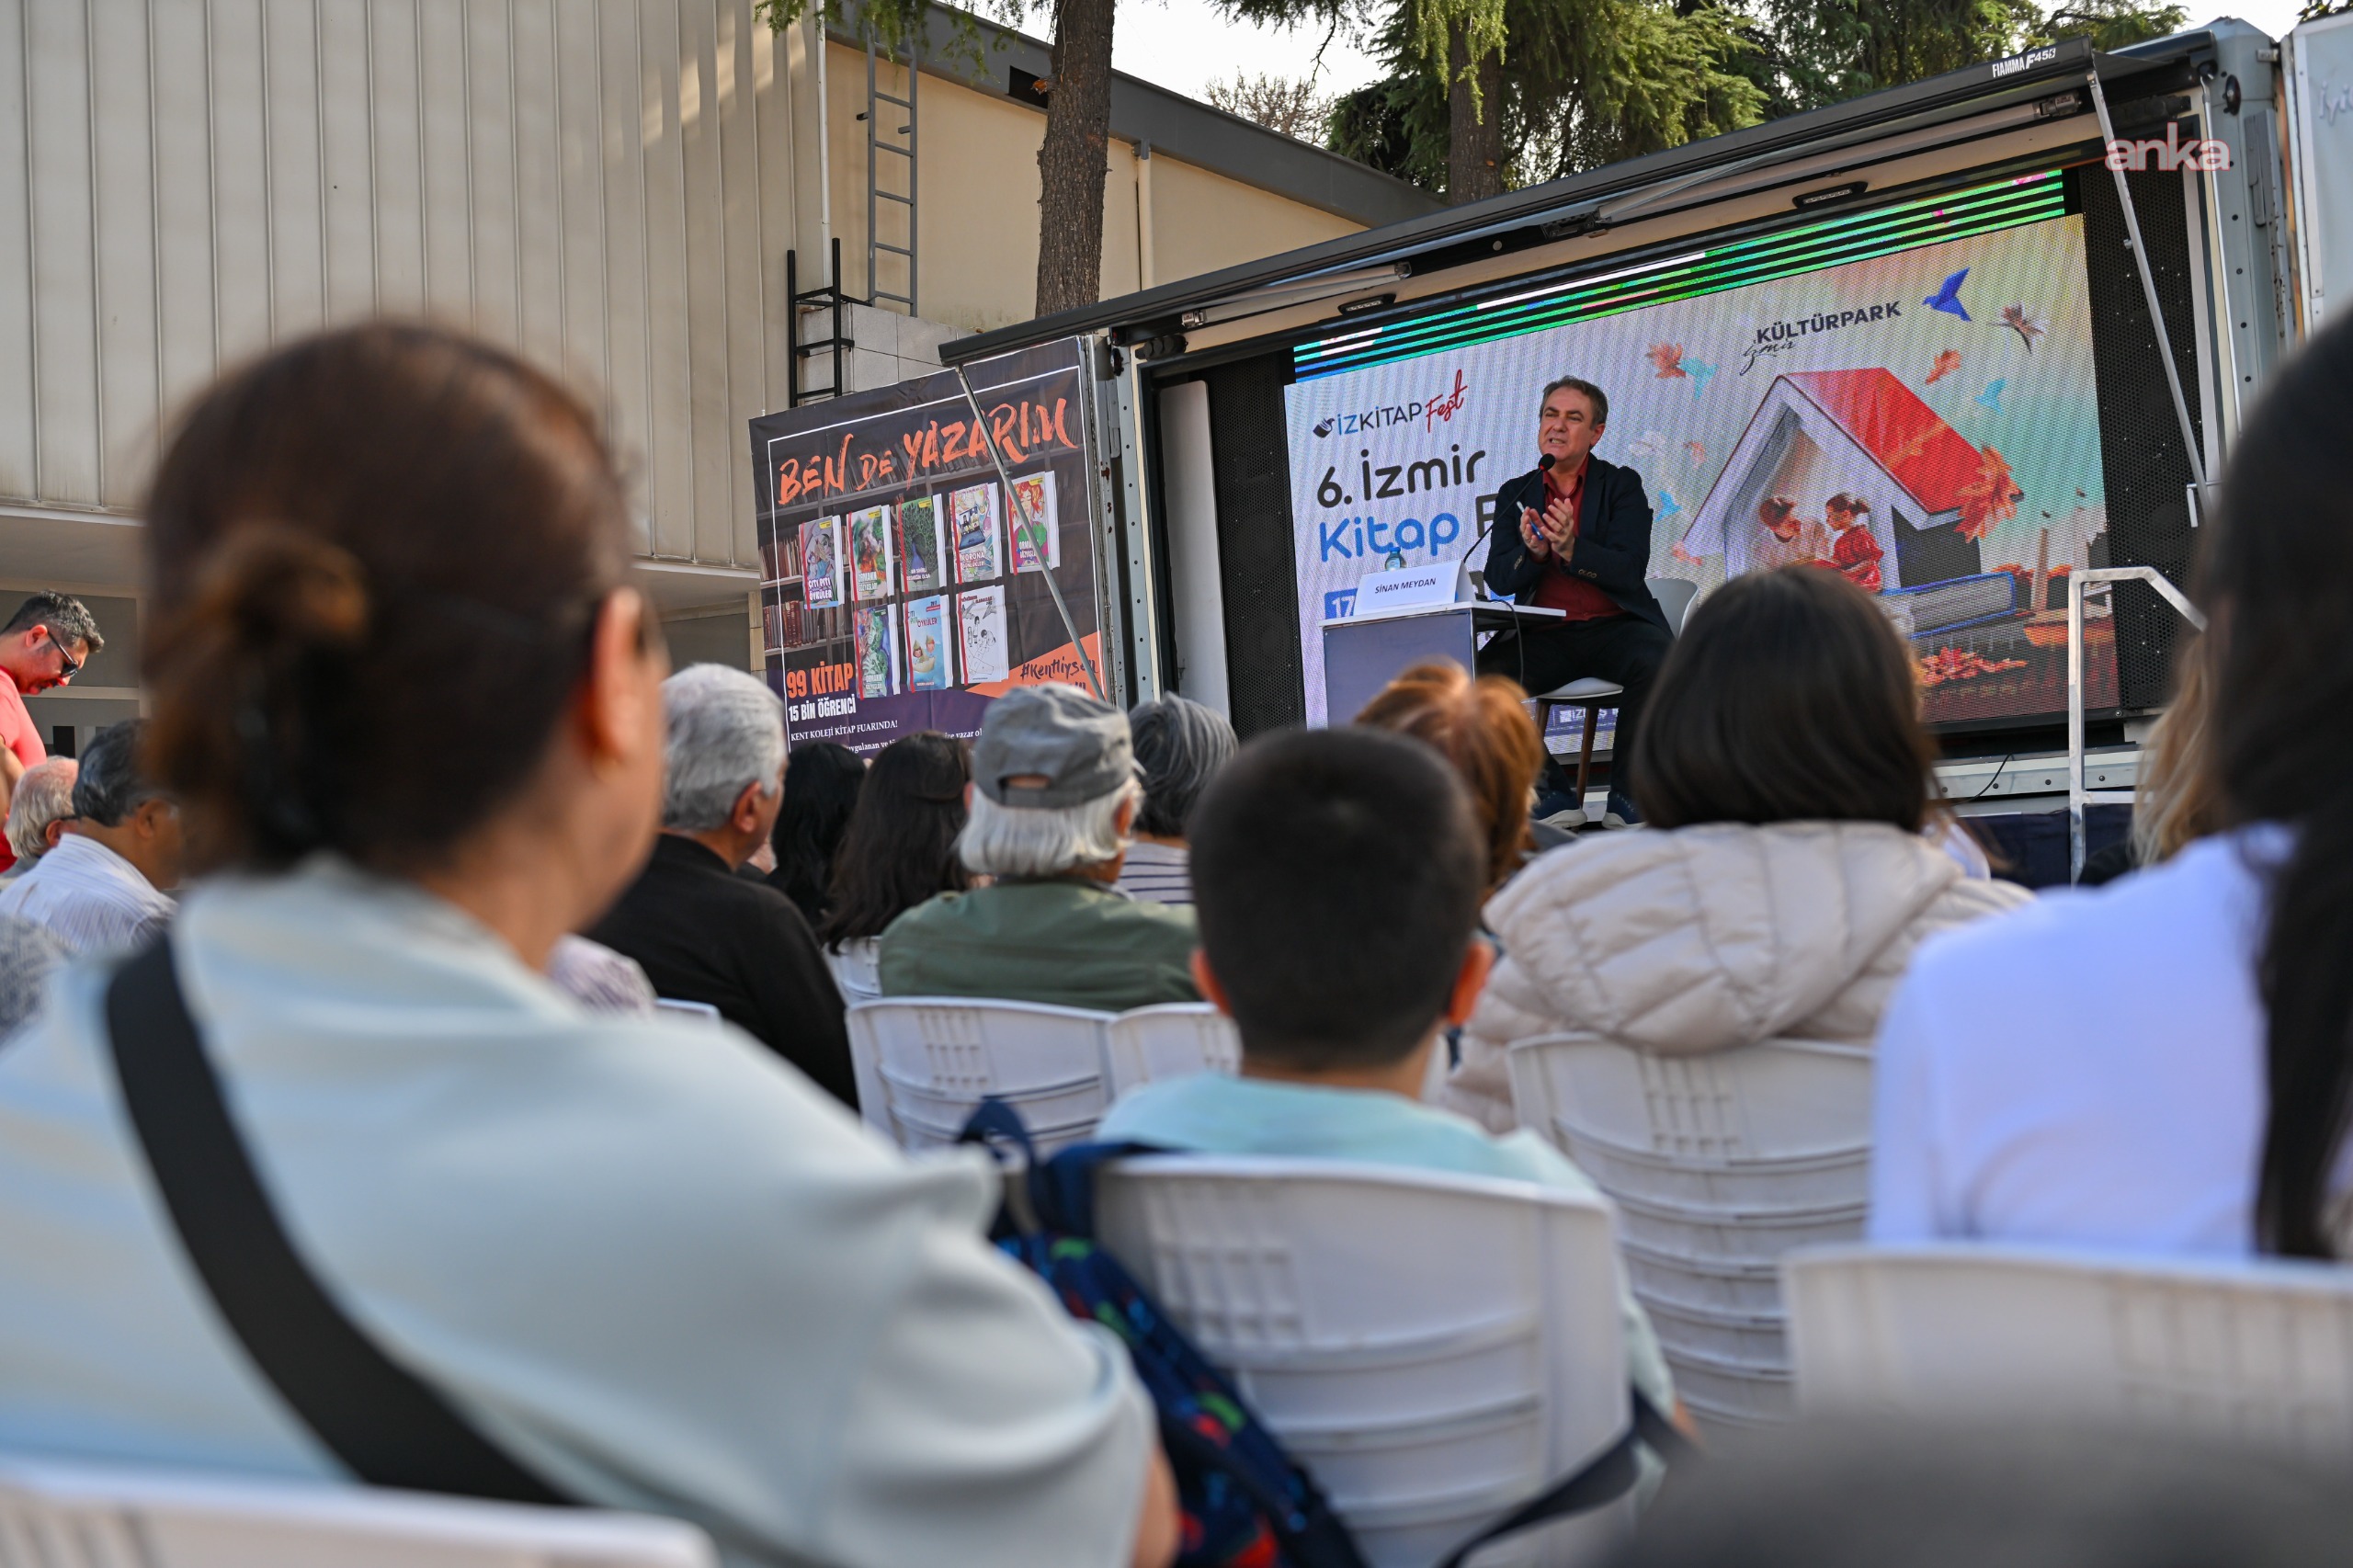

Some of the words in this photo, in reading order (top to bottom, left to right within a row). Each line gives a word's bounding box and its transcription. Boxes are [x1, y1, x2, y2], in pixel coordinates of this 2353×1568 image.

[1992, 56, 2025, 78] FIAMMA
[1756, 301, 1902, 345] KÜLTÜRPARK
[1336, 402, 1423, 436] İZKİTAP
[1425, 369, 1469, 433] Fest
[778, 433, 854, 505] BEN
[903, 397, 1079, 491] YAZARIM
[1317, 466, 1353, 508] 6.
[1360, 443, 1486, 501] İzmir
[1319, 512, 1461, 563] Kitap
[1374, 583, 1400, 594] SİNAN
[1400, 577, 1437, 590] MEYDAN
[786, 668, 807, 699] 99
[811, 661, 855, 695] KİTAP
[788, 705, 799, 722] 15
[801, 699, 816, 722] BİN
[818, 693, 857, 718] ÖĞRENCİ
[790, 731, 810, 742] KENT
[810, 727, 835, 740] KOLEJİ
[835, 724, 856, 736] KİTAP
[857, 719, 898, 733] FUARINDA!
